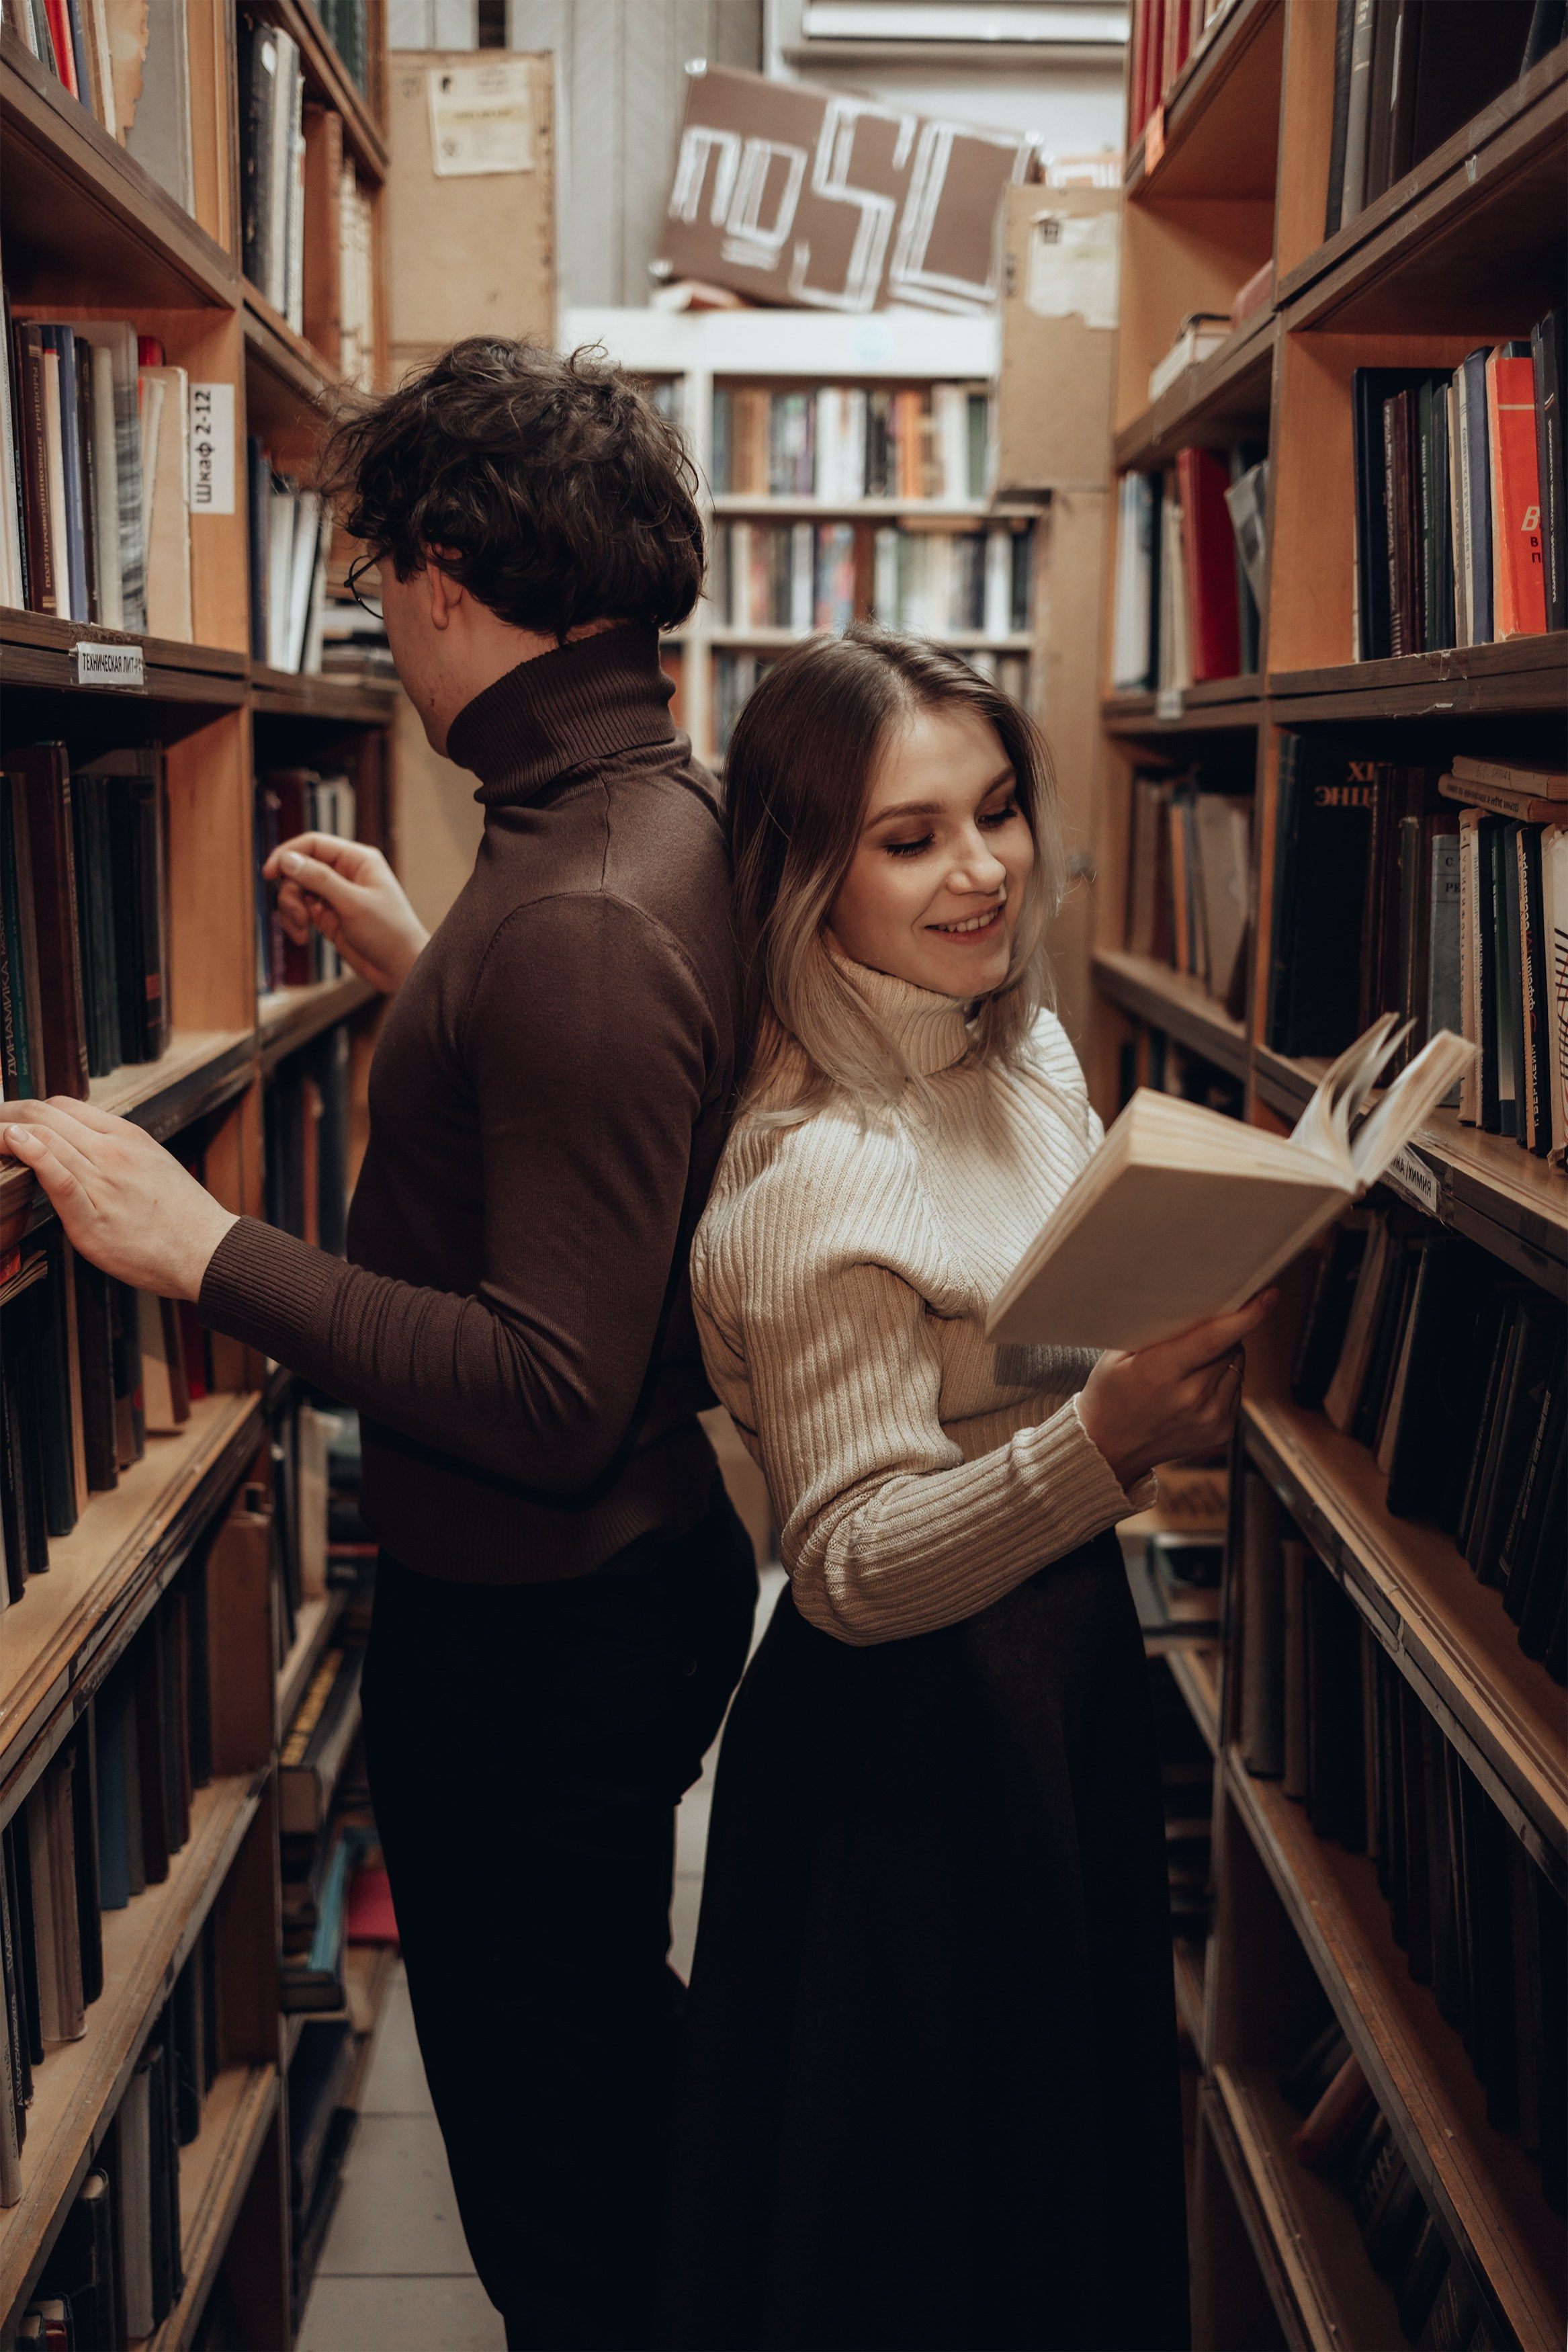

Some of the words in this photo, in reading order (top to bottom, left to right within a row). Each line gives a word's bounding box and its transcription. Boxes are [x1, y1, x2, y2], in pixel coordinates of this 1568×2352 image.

[195, 390, 211, 434] 2-12
[195, 442, 215, 503] Шкаф
[83, 653, 122, 672] ТЕХНИЧЕСКАЯ
[1, 961, 17, 1075] ДИНАМИКА
